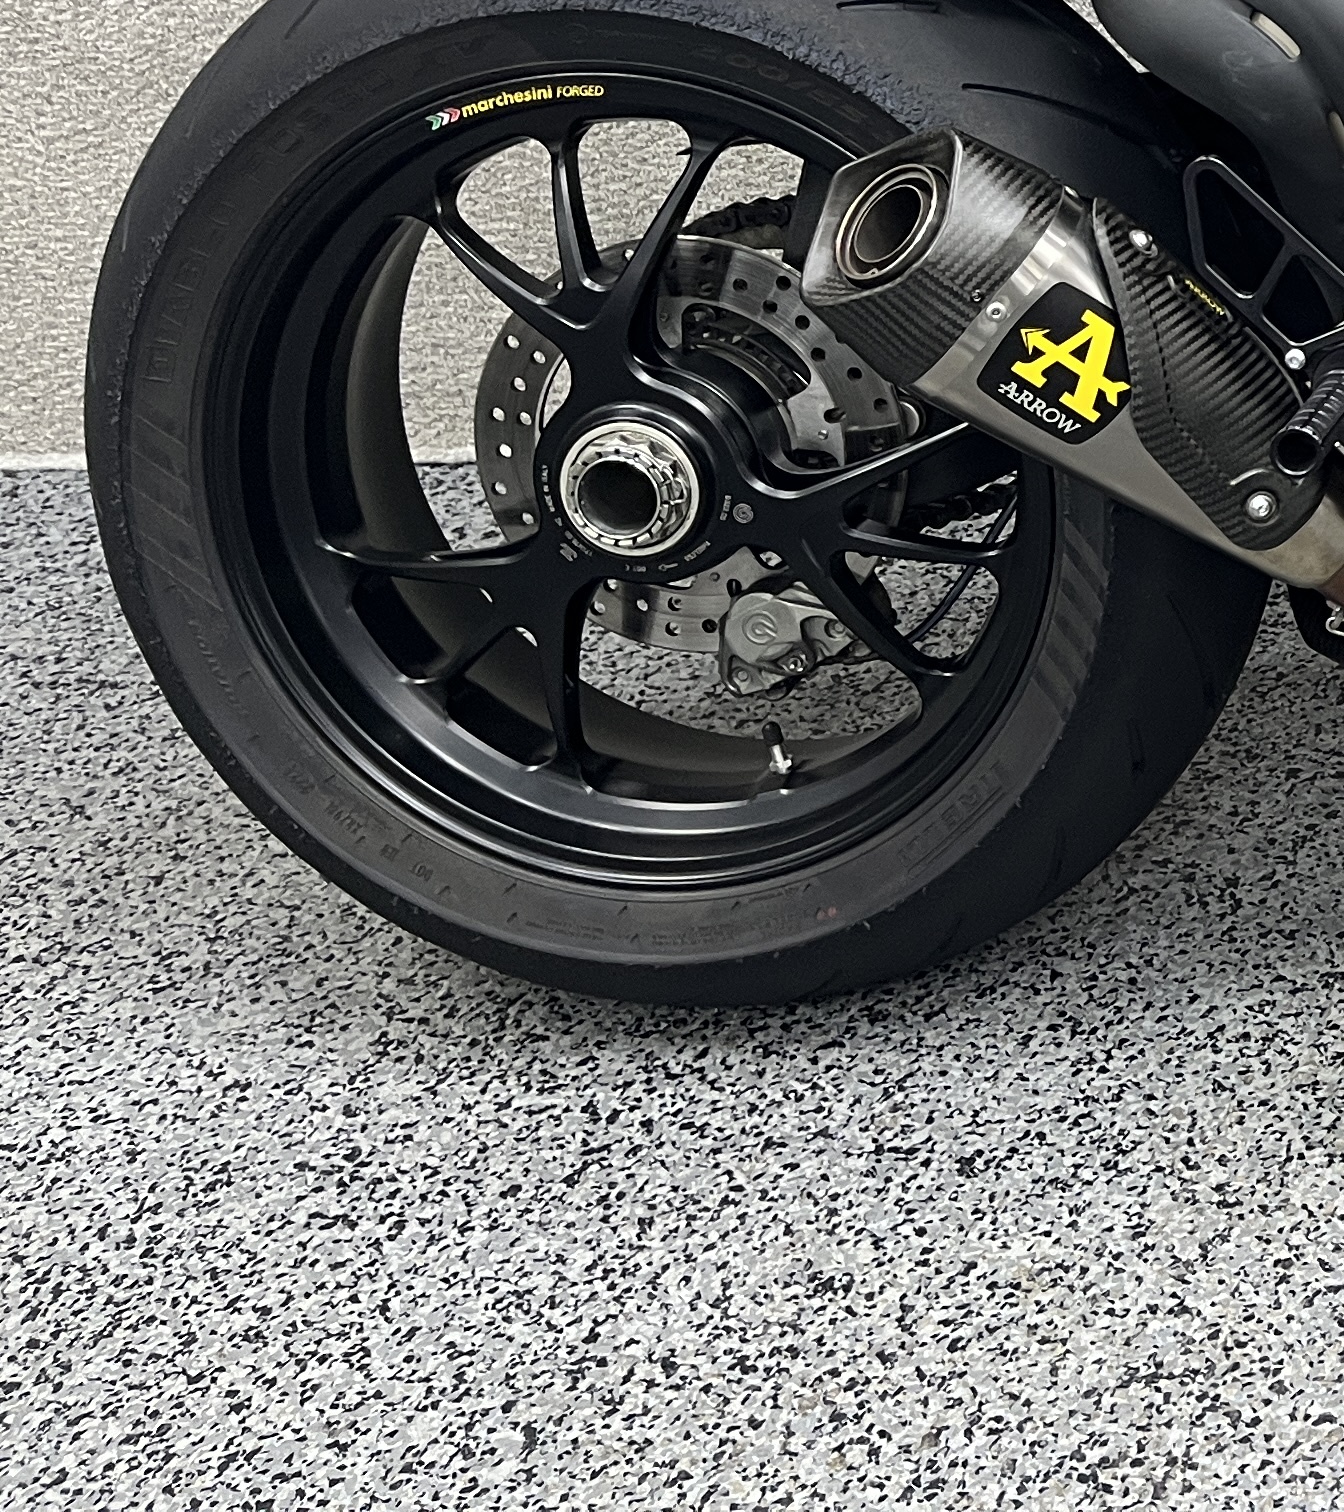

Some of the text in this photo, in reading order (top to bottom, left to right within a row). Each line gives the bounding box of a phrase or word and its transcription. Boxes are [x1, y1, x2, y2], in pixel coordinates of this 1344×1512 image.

[461, 84, 605, 118] marchesini FORGED
[998, 381, 1082, 434] ARROW
